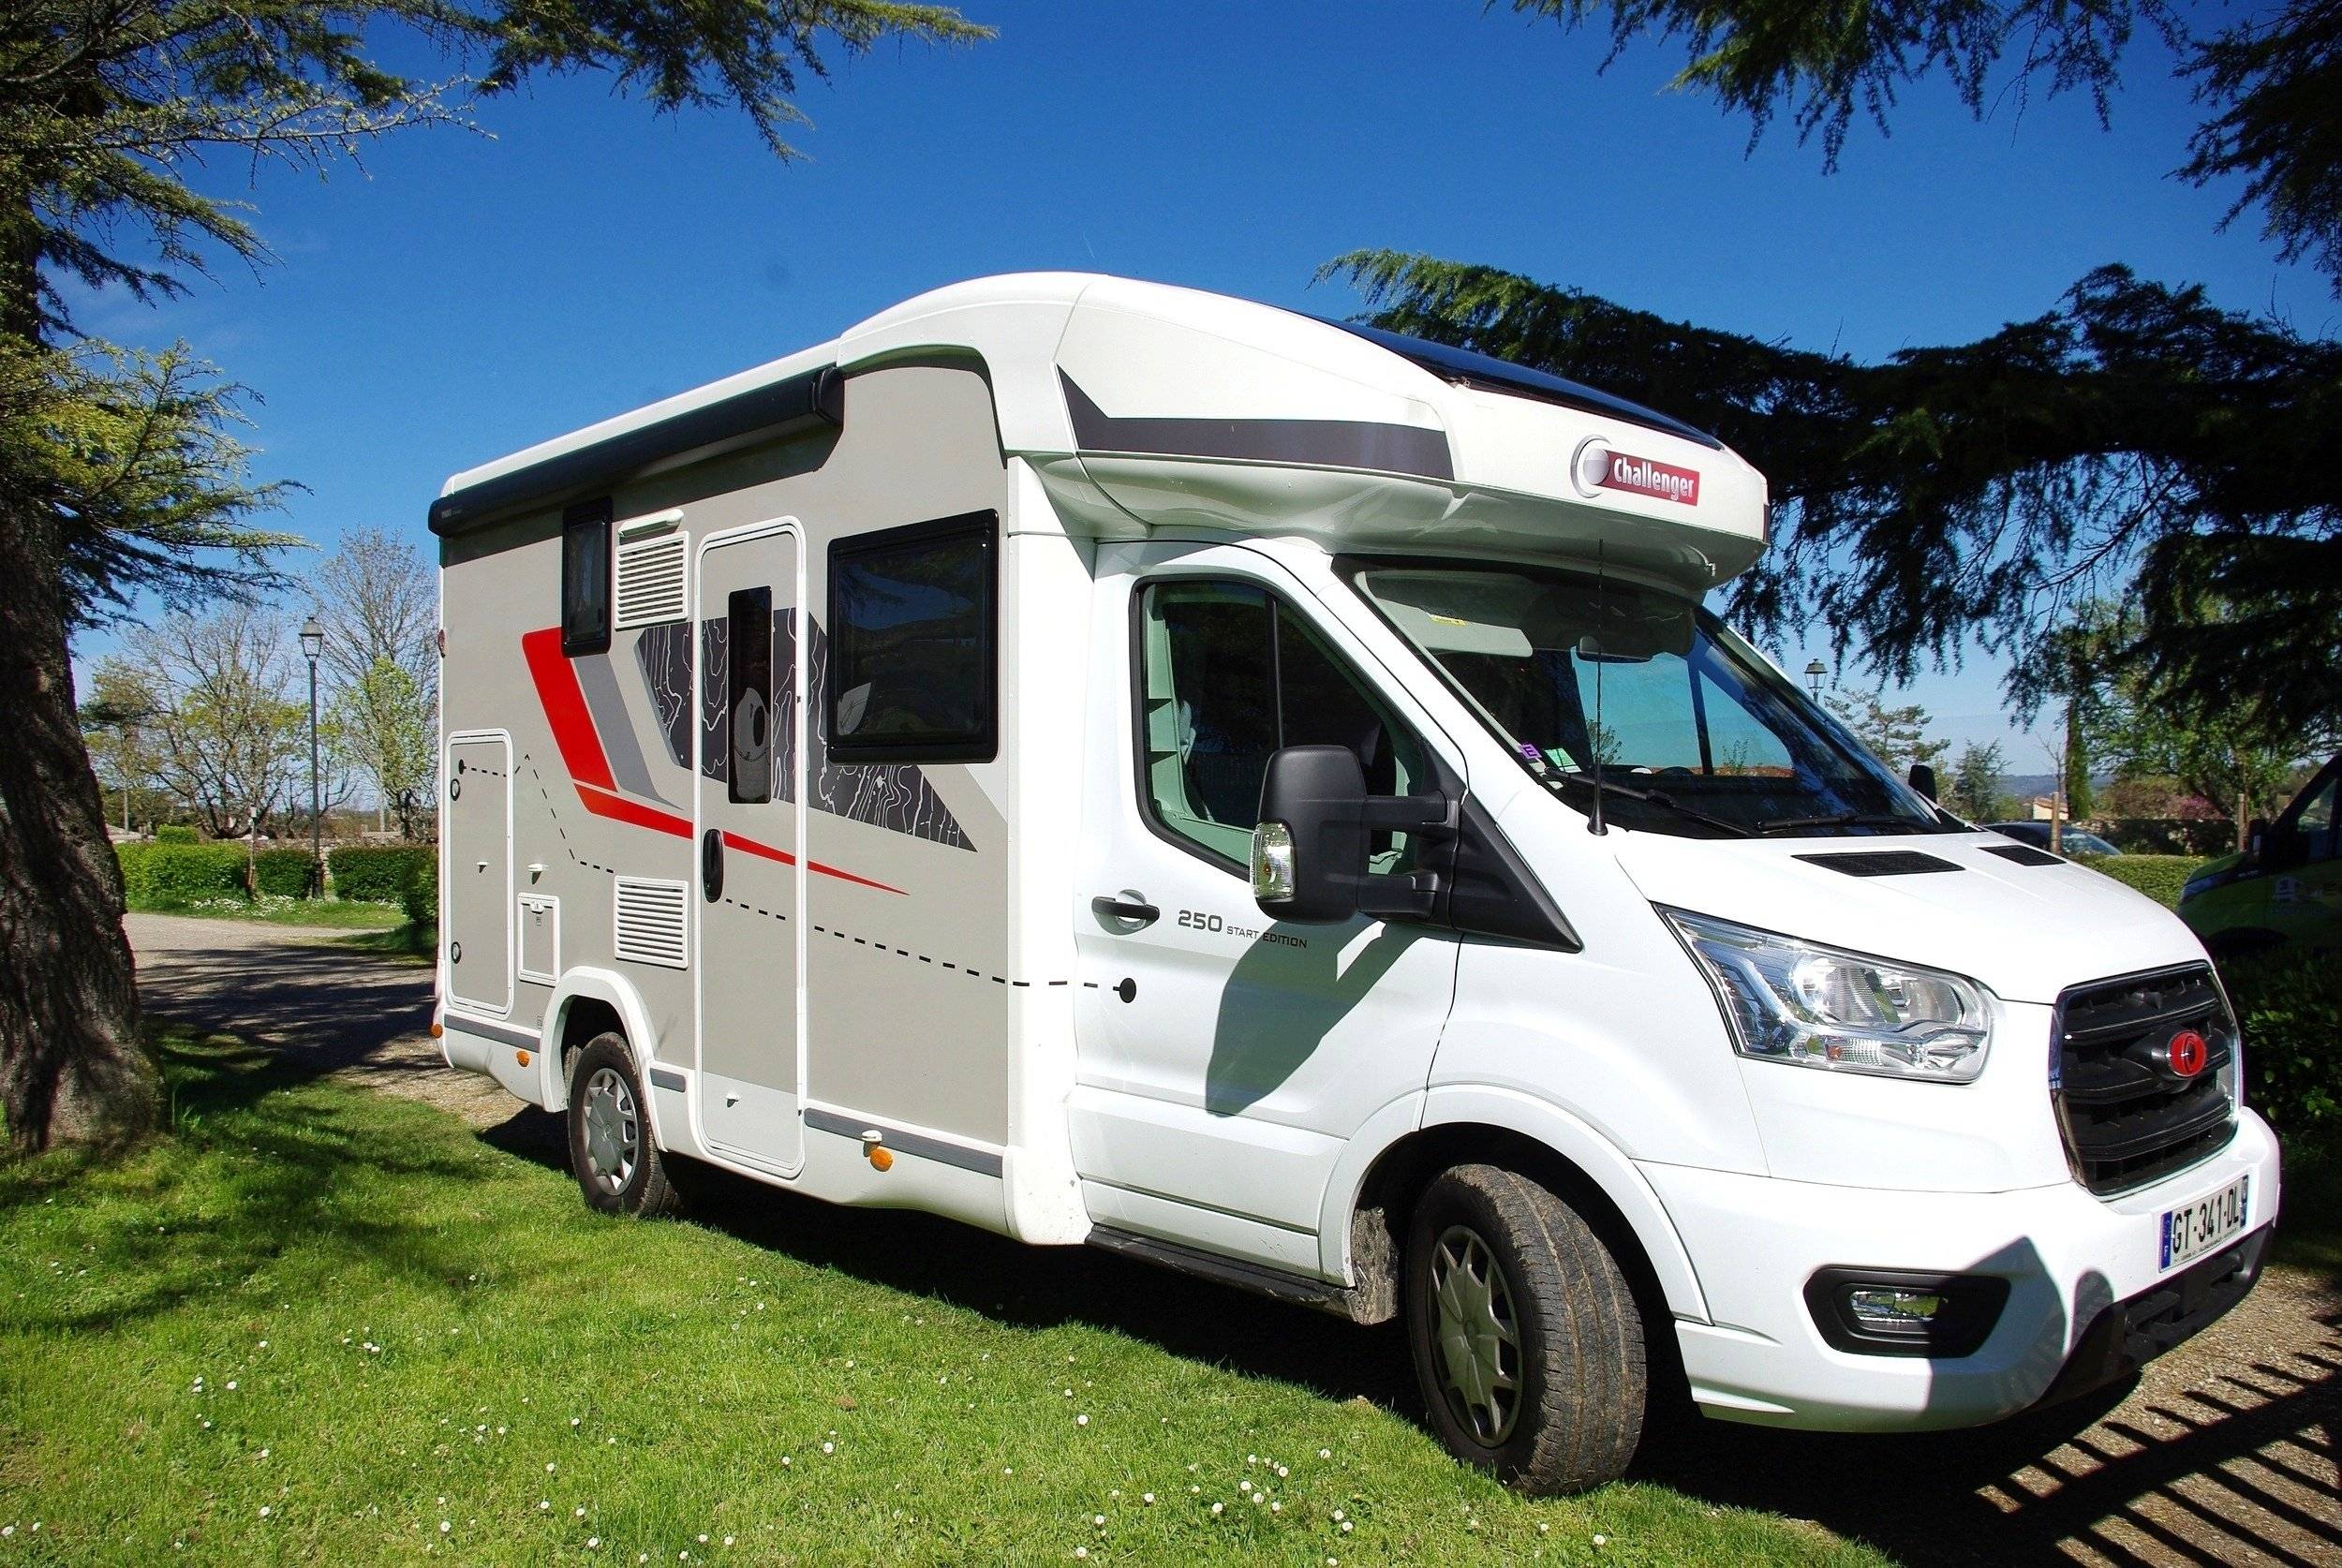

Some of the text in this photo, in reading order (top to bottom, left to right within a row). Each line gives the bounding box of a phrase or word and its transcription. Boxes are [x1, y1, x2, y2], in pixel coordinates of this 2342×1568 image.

[1613, 456, 1695, 501] Challenger
[1178, 910, 1308, 949] 250 START EDITION
